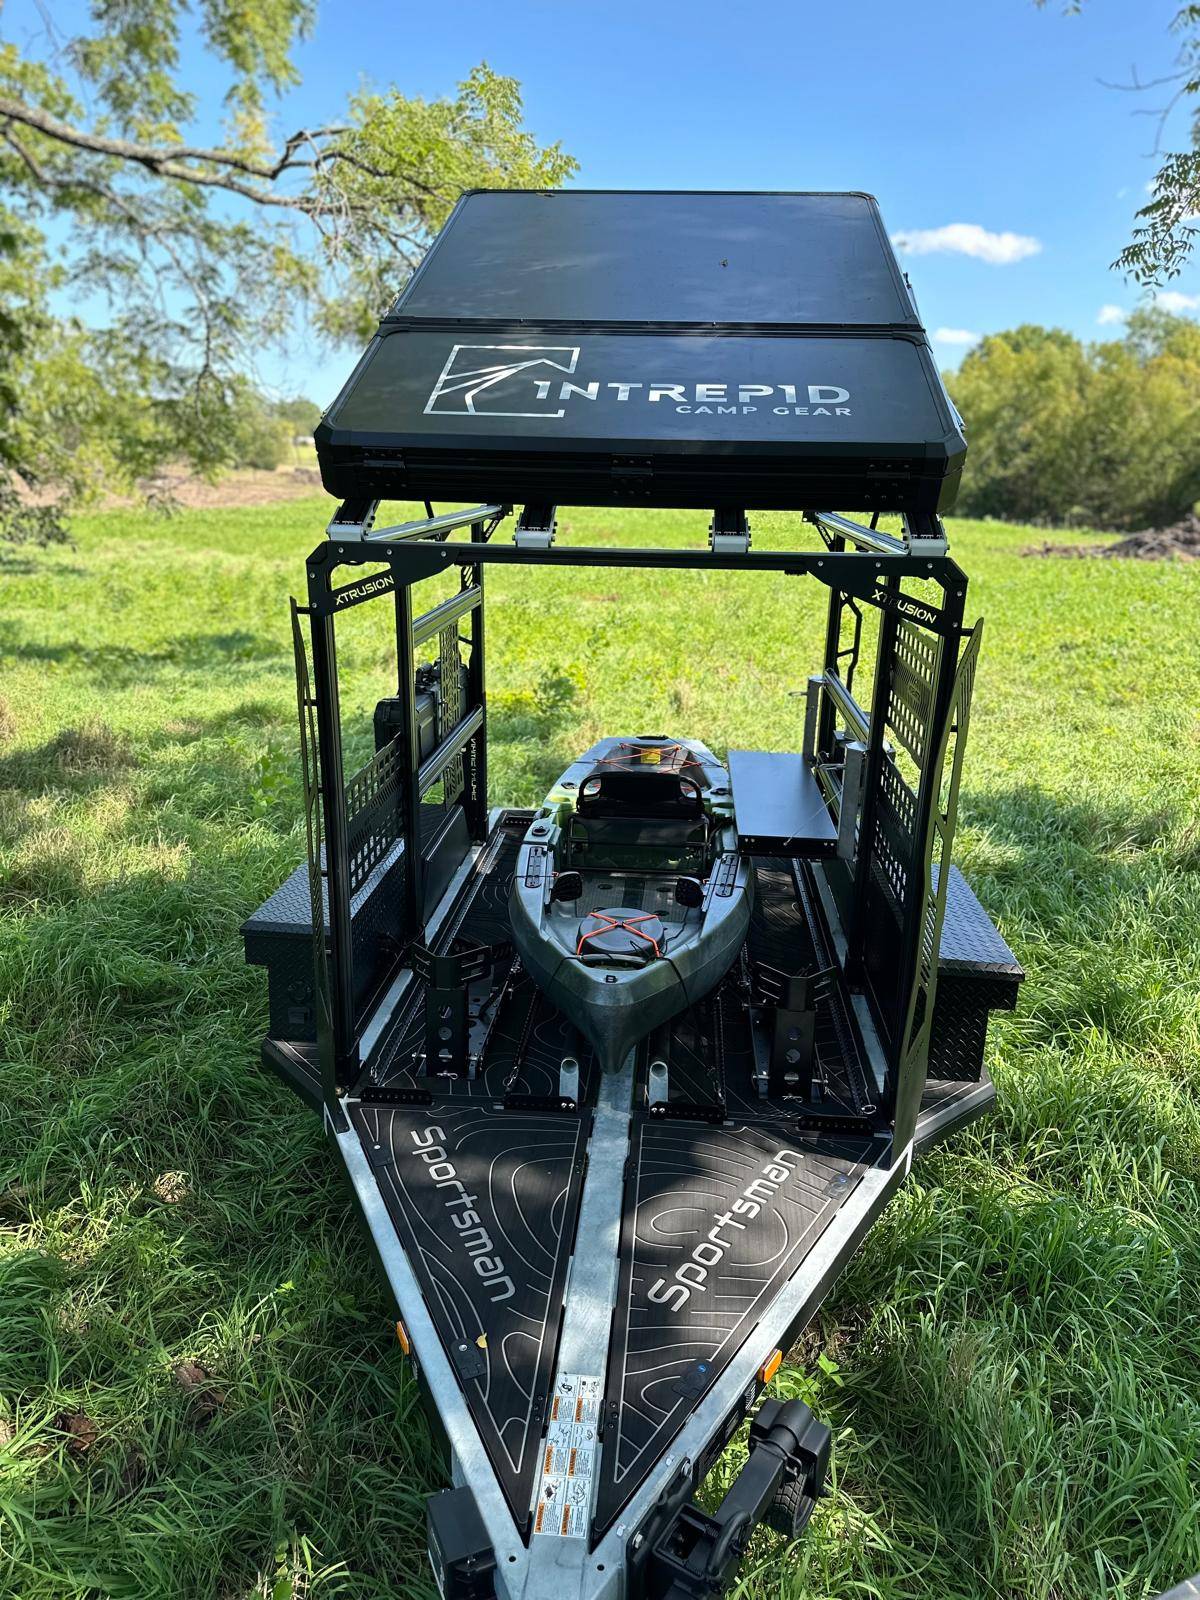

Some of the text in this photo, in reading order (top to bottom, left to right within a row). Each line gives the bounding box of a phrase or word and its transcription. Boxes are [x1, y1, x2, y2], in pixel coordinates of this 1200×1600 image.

[675, 405, 852, 416] CAMP GEAR
[335, 575, 395, 605] XTRUSION
[871, 589, 937, 624] XTUSION
[410, 1125, 516, 1303] Sportsman
[647, 1149, 805, 1313] Sportsman
